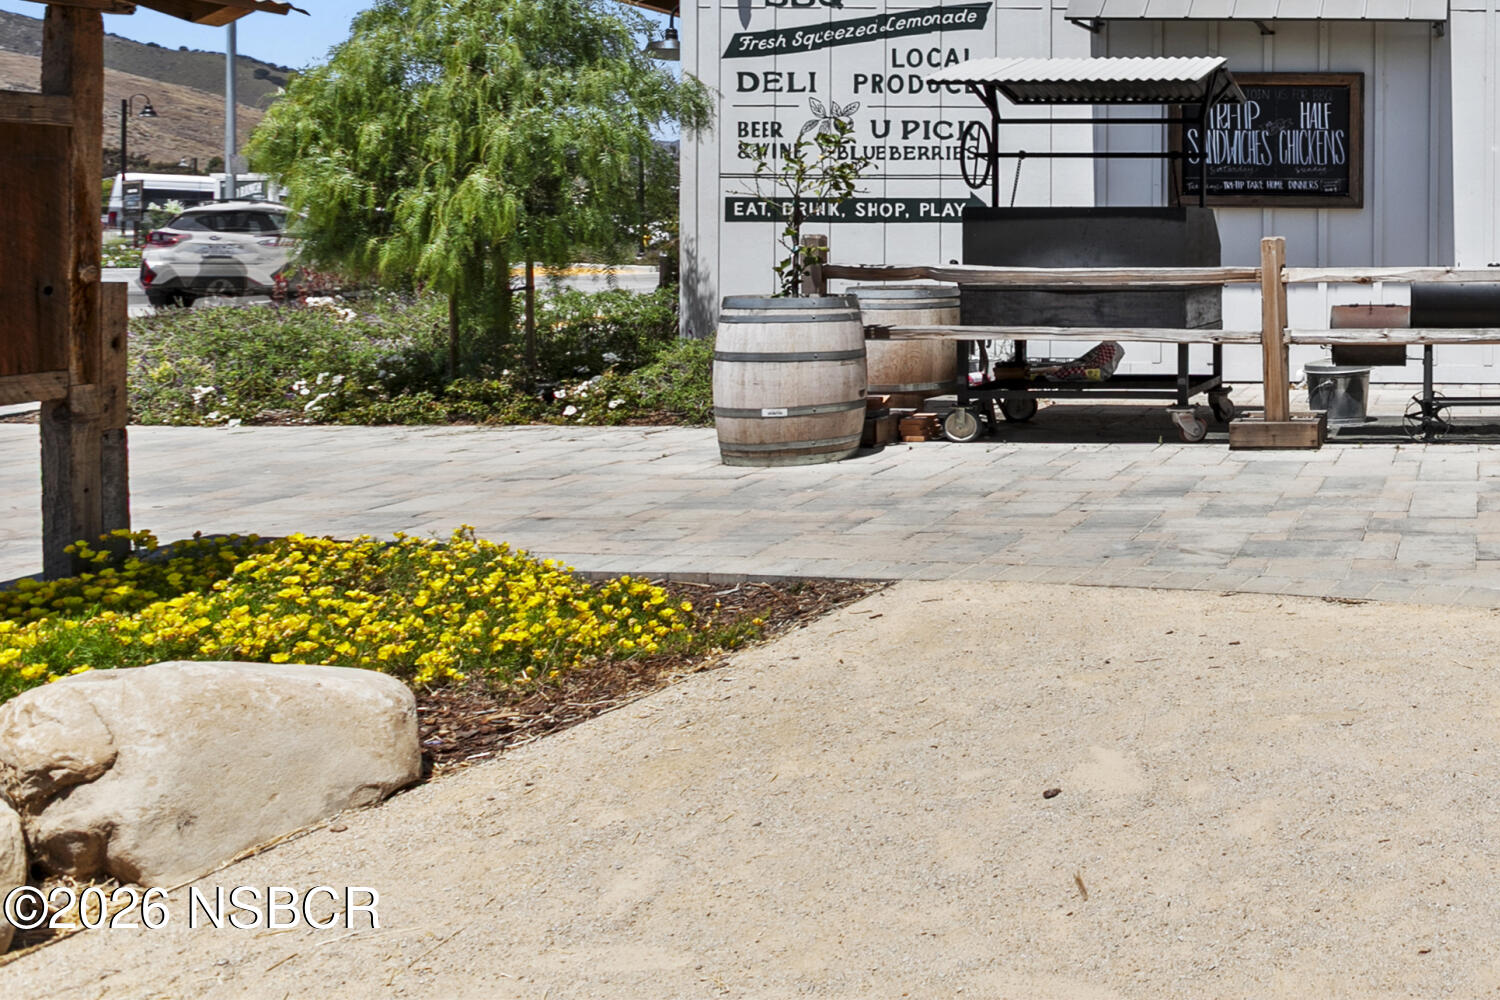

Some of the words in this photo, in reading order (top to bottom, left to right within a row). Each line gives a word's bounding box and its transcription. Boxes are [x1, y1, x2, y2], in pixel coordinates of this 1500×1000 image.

[739, 32, 786, 51] Fresh
[792, 19, 878, 45] Squeezed
[879, 8, 978, 32] Lemonade
[736, 71, 817, 93] DELI
[1300, 101, 1332, 130] HALF
[737, 121, 784, 138] BEER
[870, 119, 892, 139] U
[902, 120, 979, 140] PICK
[837, 145, 978, 161] BLUEBERRIES
[1187, 128, 1273, 165] SNDWICHES
[1279, 129, 1346, 165] CHICKENS
[733, 202, 772, 217] EAT,
[782, 202, 846, 218] DRINK,
[855, 203, 910, 218] SHOP,
[919, 203, 966, 217] PLAY
